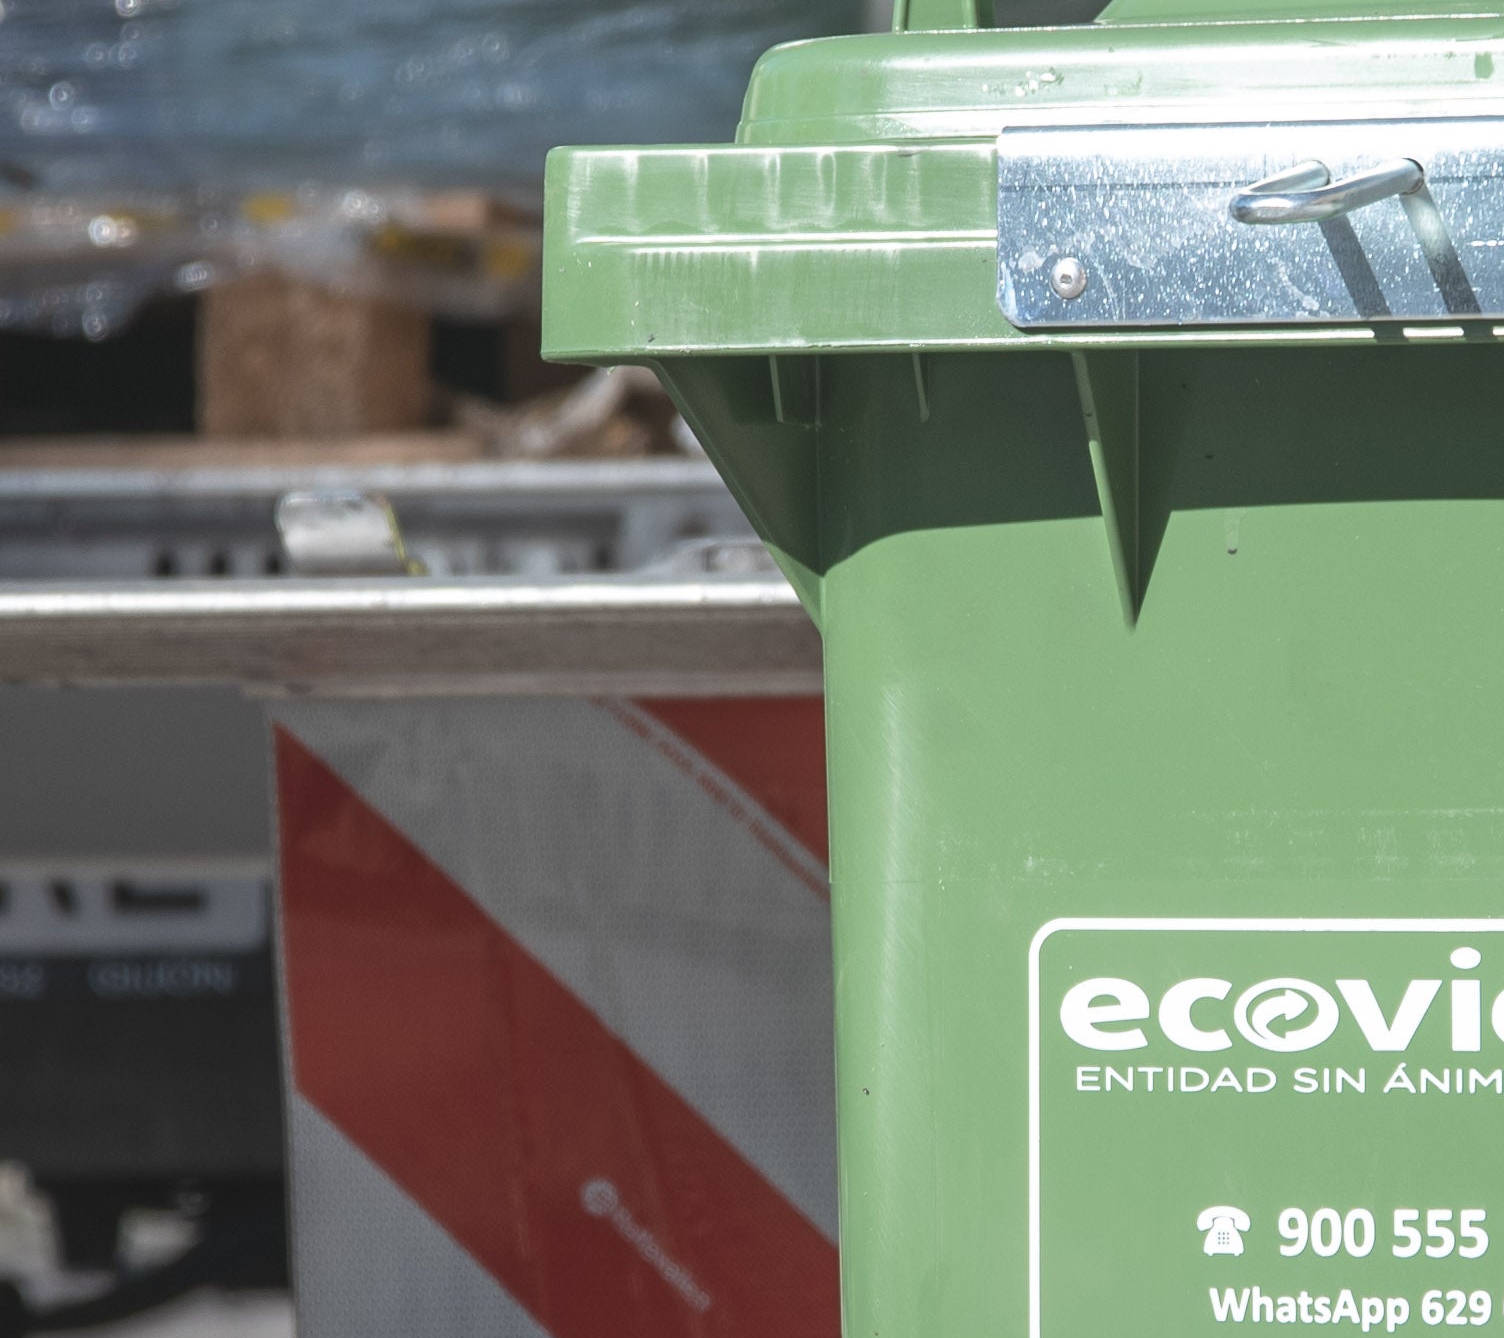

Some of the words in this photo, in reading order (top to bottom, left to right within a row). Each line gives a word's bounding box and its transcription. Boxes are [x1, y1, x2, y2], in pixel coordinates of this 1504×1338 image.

[1076, 1066, 1277, 1093] ENTIDAD
[1293, 1067, 1366, 1093] SIN
[1278, 1207, 1375, 1258] 900
[1392, 1208, 1489, 1259] 555
[1209, 1285, 1410, 1333] WhatsApp
[1421, 1289, 1493, 1327] 629
